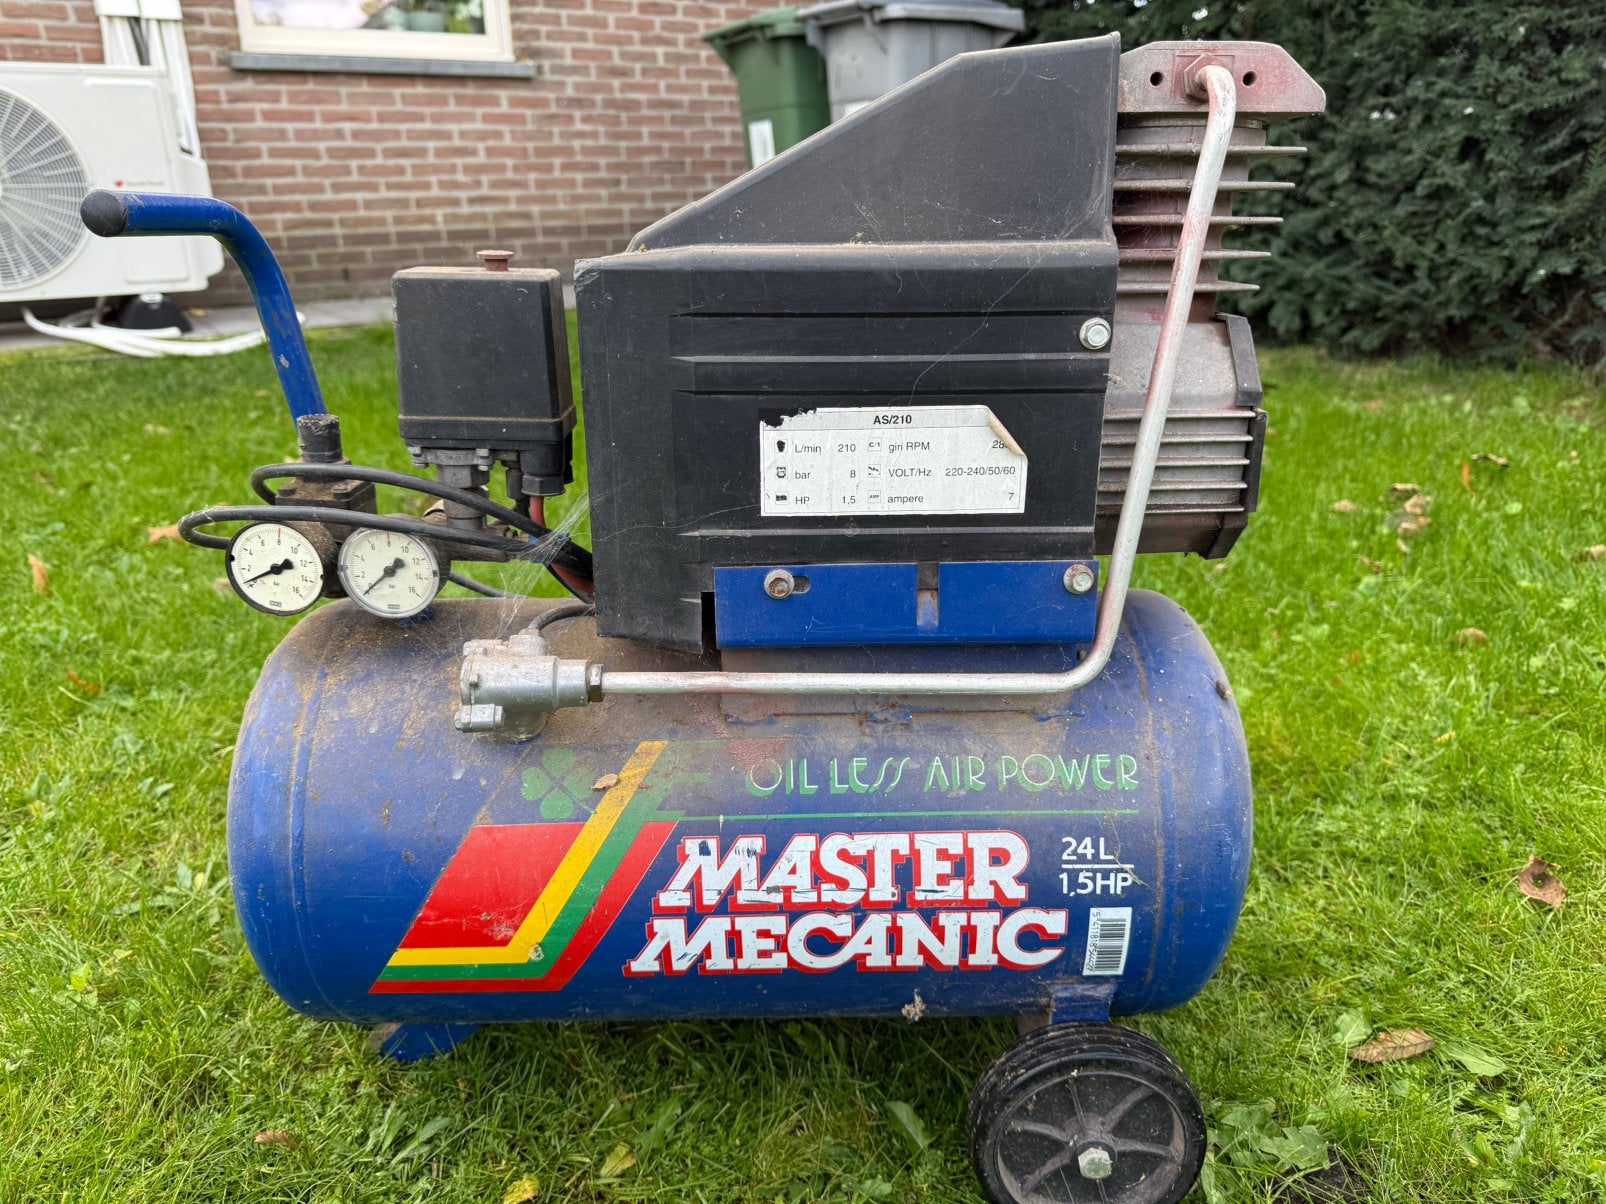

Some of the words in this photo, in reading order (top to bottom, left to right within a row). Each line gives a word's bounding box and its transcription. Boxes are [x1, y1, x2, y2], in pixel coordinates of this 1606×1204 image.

[873, 414, 912, 425] AS/210
[794, 443, 822, 453] L/min
[837, 443, 857, 453] 210
[906, 441, 931, 451] RPM
[794, 470, 812, 480] bar
[850, 469, 857, 479] 8
[888, 468, 932, 478] VOLT/Hz
[945, 466, 1017, 477] 220-240/50/60
[795, 495, 811, 505] HP
[841, 495, 857, 506] 1,5
[887, 494, 924, 505] ampere
[1007, 492, 1015, 501] 7
[290, 546, 299, 554] 10
[412, 558, 420, 566] 12
[361, 571, 366, 579] 2
[745, 757, 818, 798] OIL
[829, 756, 910, 795] LESS
[923, 755, 986, 793] AIR
[997, 753, 1139, 792] POWER
[652, 830, 1030, 914] MASTER
[1058, 871, 1133, 897] 1,5HP
[622, 907, 1069, 977] MECANIC
